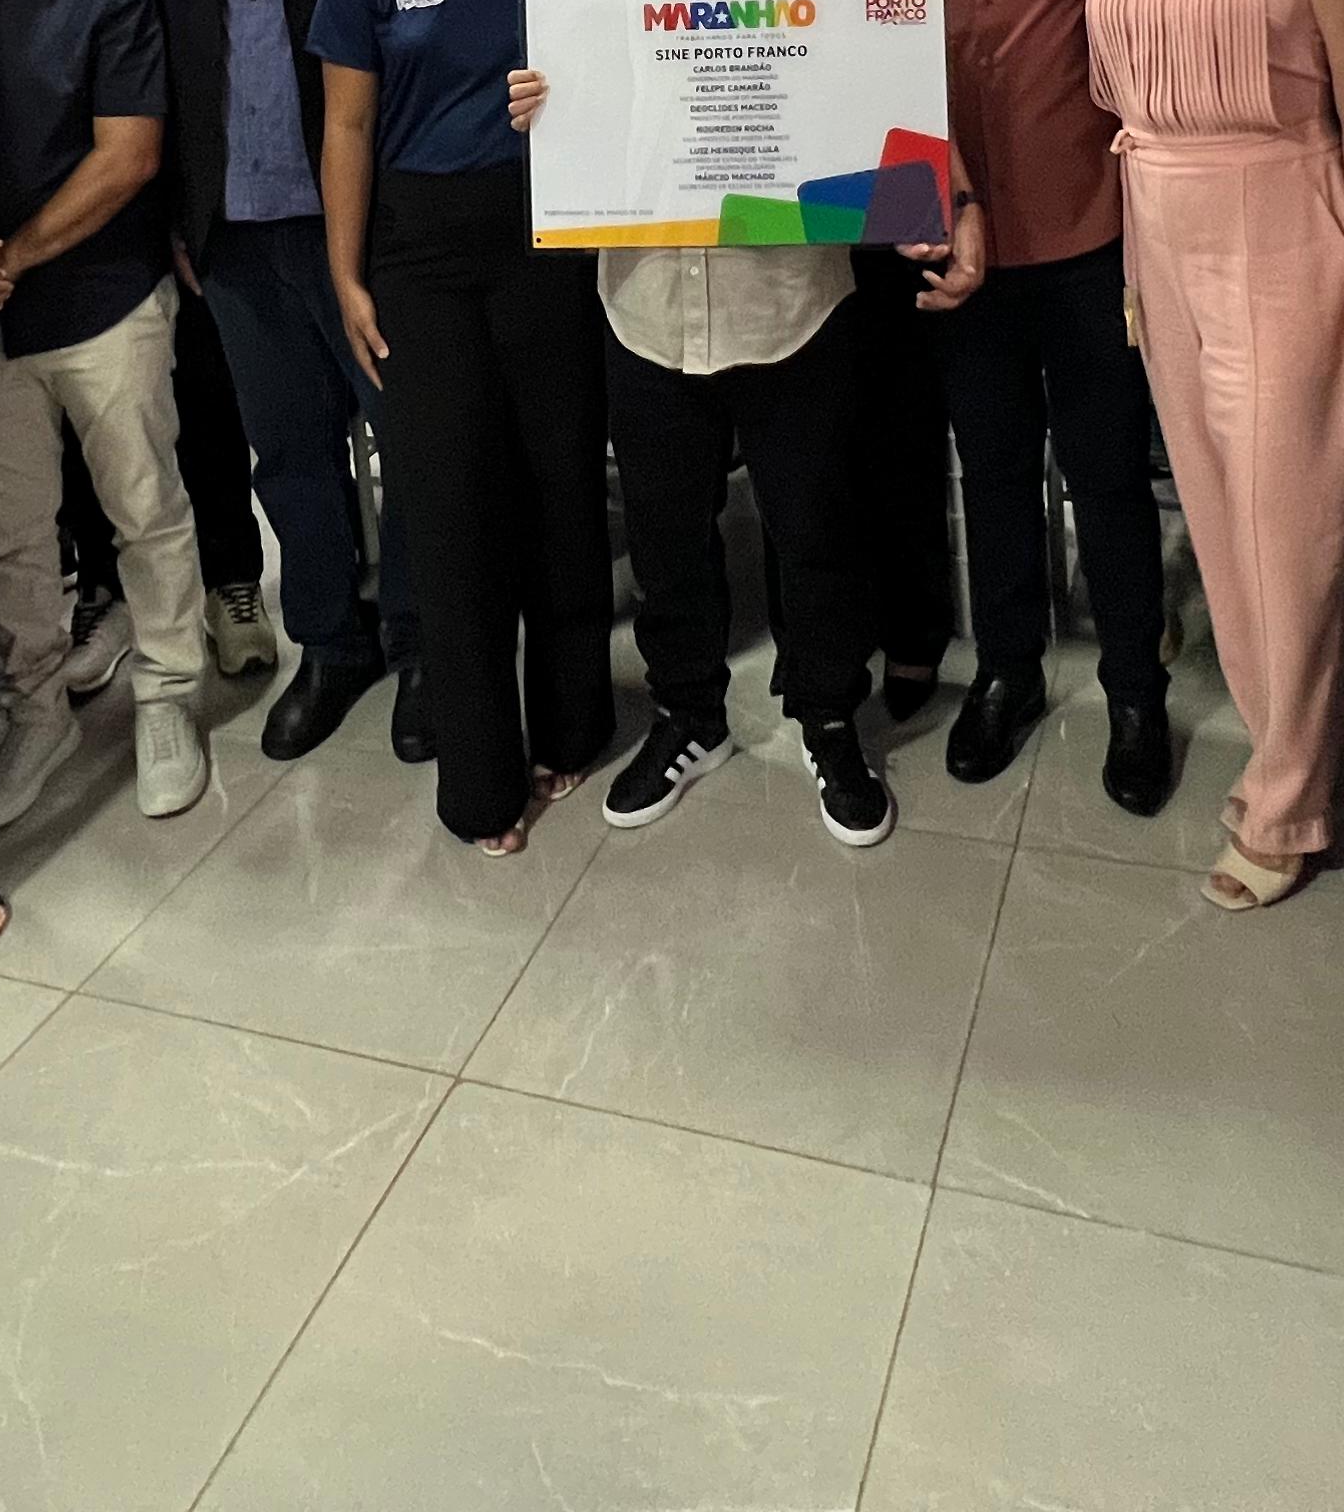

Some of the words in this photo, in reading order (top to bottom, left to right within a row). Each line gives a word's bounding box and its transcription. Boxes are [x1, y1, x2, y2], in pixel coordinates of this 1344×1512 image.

[866, 9, 927, 21] FRANCO
[655, 48, 690, 60] SINE
[694, 47, 743, 60] PORTO
[747, 45, 808, 58] FRANCO
[693, 65, 727, 73] CARLOS
[695, 84, 726, 93] FELIPE
[690, 104, 739, 113] DEOCLIDES
[740, 103, 778, 112] MACEDO
[744, 124, 775, 132] ROCHA
[689, 147, 708, 155] LUIZ
[710, 146, 756, 156] HENRIQUE
[758, 145, 780, 154] LULA
[695, 172, 729, 181] MÁRCIO
[731, 172, 776, 181] MACHADO
